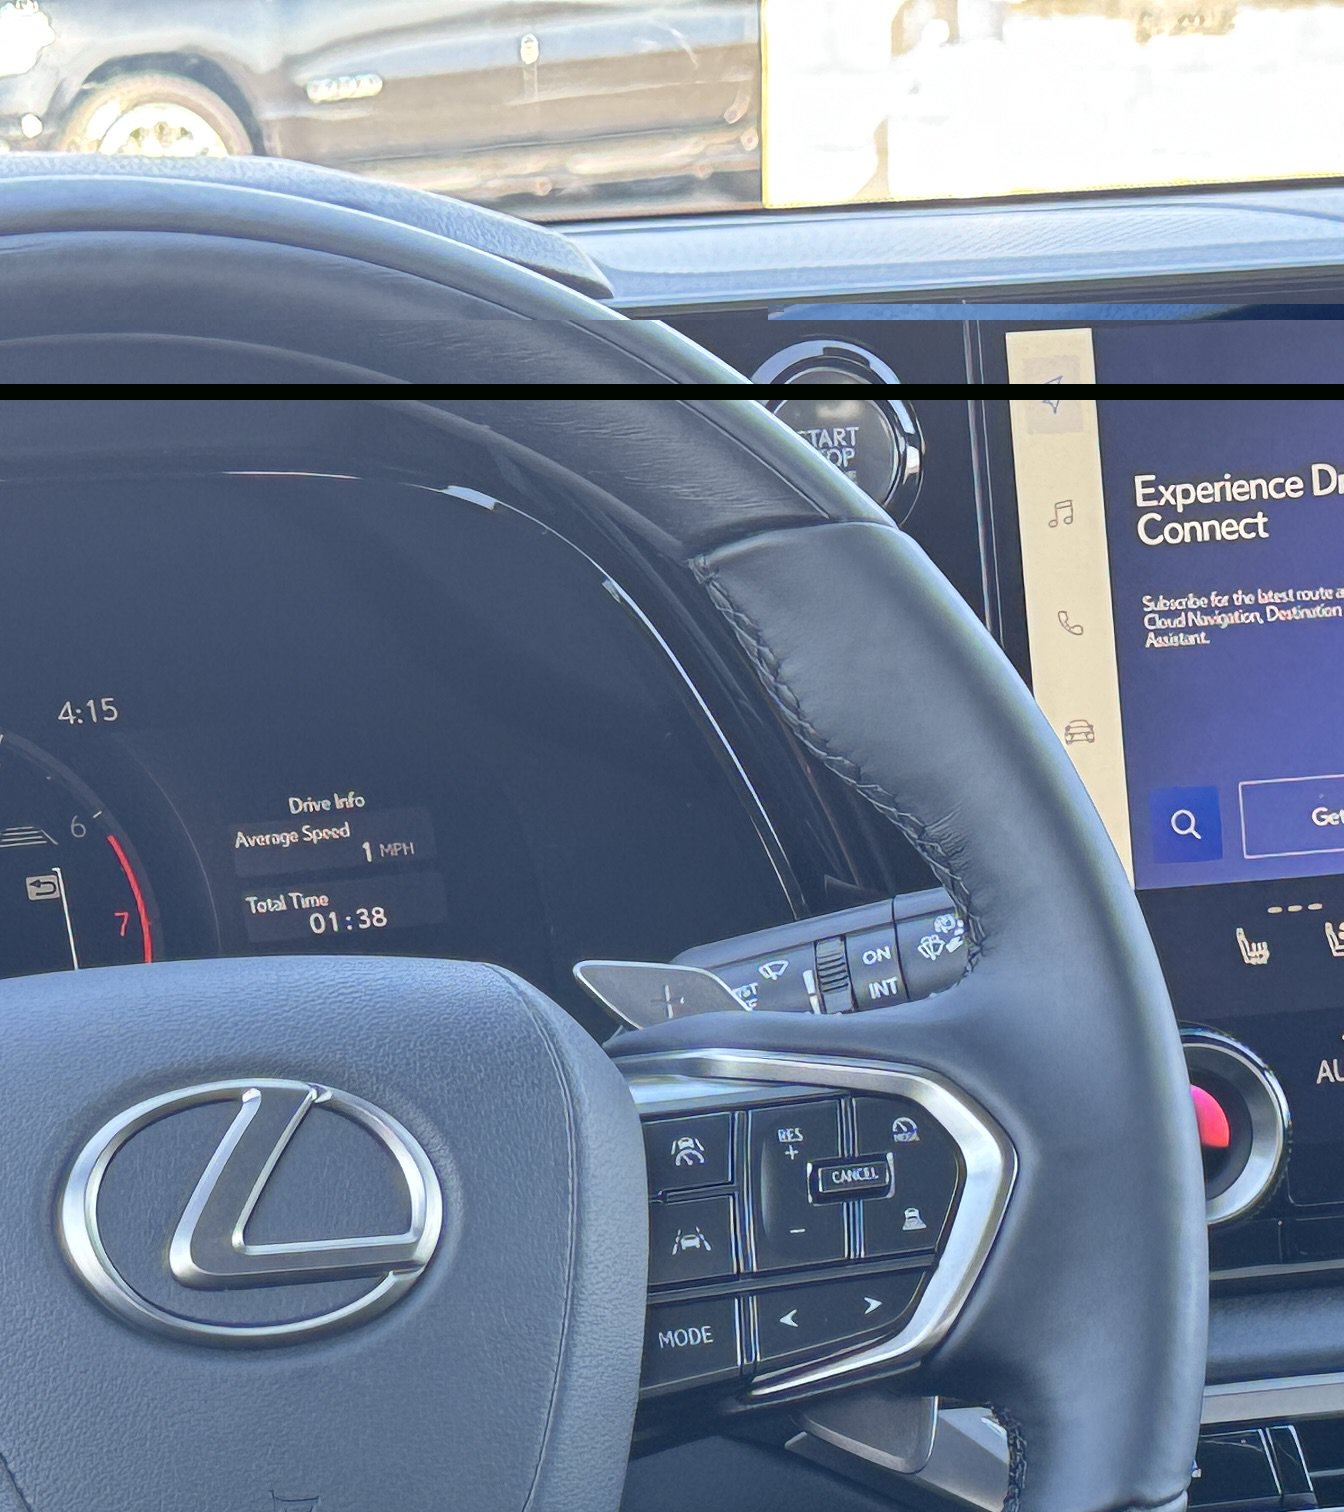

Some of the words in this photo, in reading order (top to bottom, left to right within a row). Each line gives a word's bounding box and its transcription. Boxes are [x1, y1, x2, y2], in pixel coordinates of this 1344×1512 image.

[1134, 468, 1304, 511] Experience
[1137, 510, 1270, 546] Connect
[1142, 593, 1208, 612] Subscribe
[1210, 592, 1229, 608] for
[1233, 590, 1255, 606] the
[1257, 587, 1295, 604] latest
[1296, 587, 1333, 602] route
[1143, 612, 1186, 630] Cloud
[1187, 607, 1265, 629] Navigation,
[1266, 602, 1342, 622] Destination
[1145, 631, 1210, 648] Assistant.
[57, 697, 120, 727] 4:15
[288, 794, 331, 814] Drive
[334, 791, 366, 811] Info
[69, 815, 86, 839] 6
[234, 827, 299, 850] Average
[301, 822, 351, 846] Speed
[362, 840, 373, 864] 1
[379, 840, 415, 858] MPH
[245, 893, 286, 913] Total
[288, 889, 329, 911] Time
[114, 911, 129, 937] 7
[309, 906, 388, 935] 01:38
[862, 945, 892, 965] ON
[868, 977, 898, 999] INT
[778, 1128, 804, 1143] RES
[832, 1167, 879, 1184] CANCEL
[658, 1325, 714, 1349] MODE
